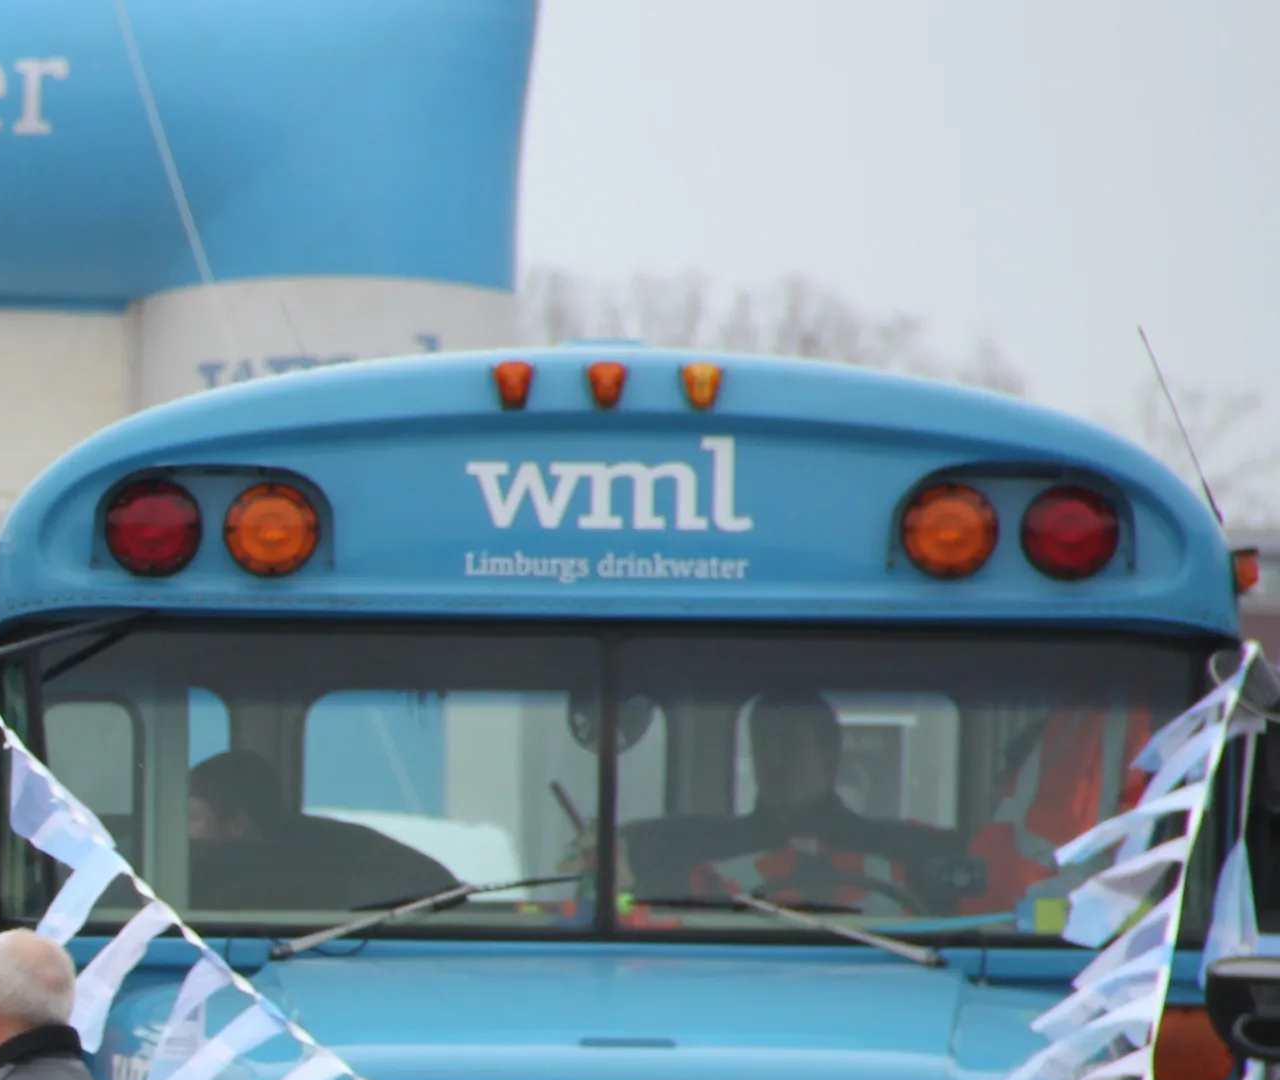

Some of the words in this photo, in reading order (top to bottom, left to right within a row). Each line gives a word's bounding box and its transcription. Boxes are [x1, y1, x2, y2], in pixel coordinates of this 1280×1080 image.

[464, 435, 755, 533] wml
[463, 551, 589, 584] Limburgs
[596, 552, 750, 580] drinkwater
